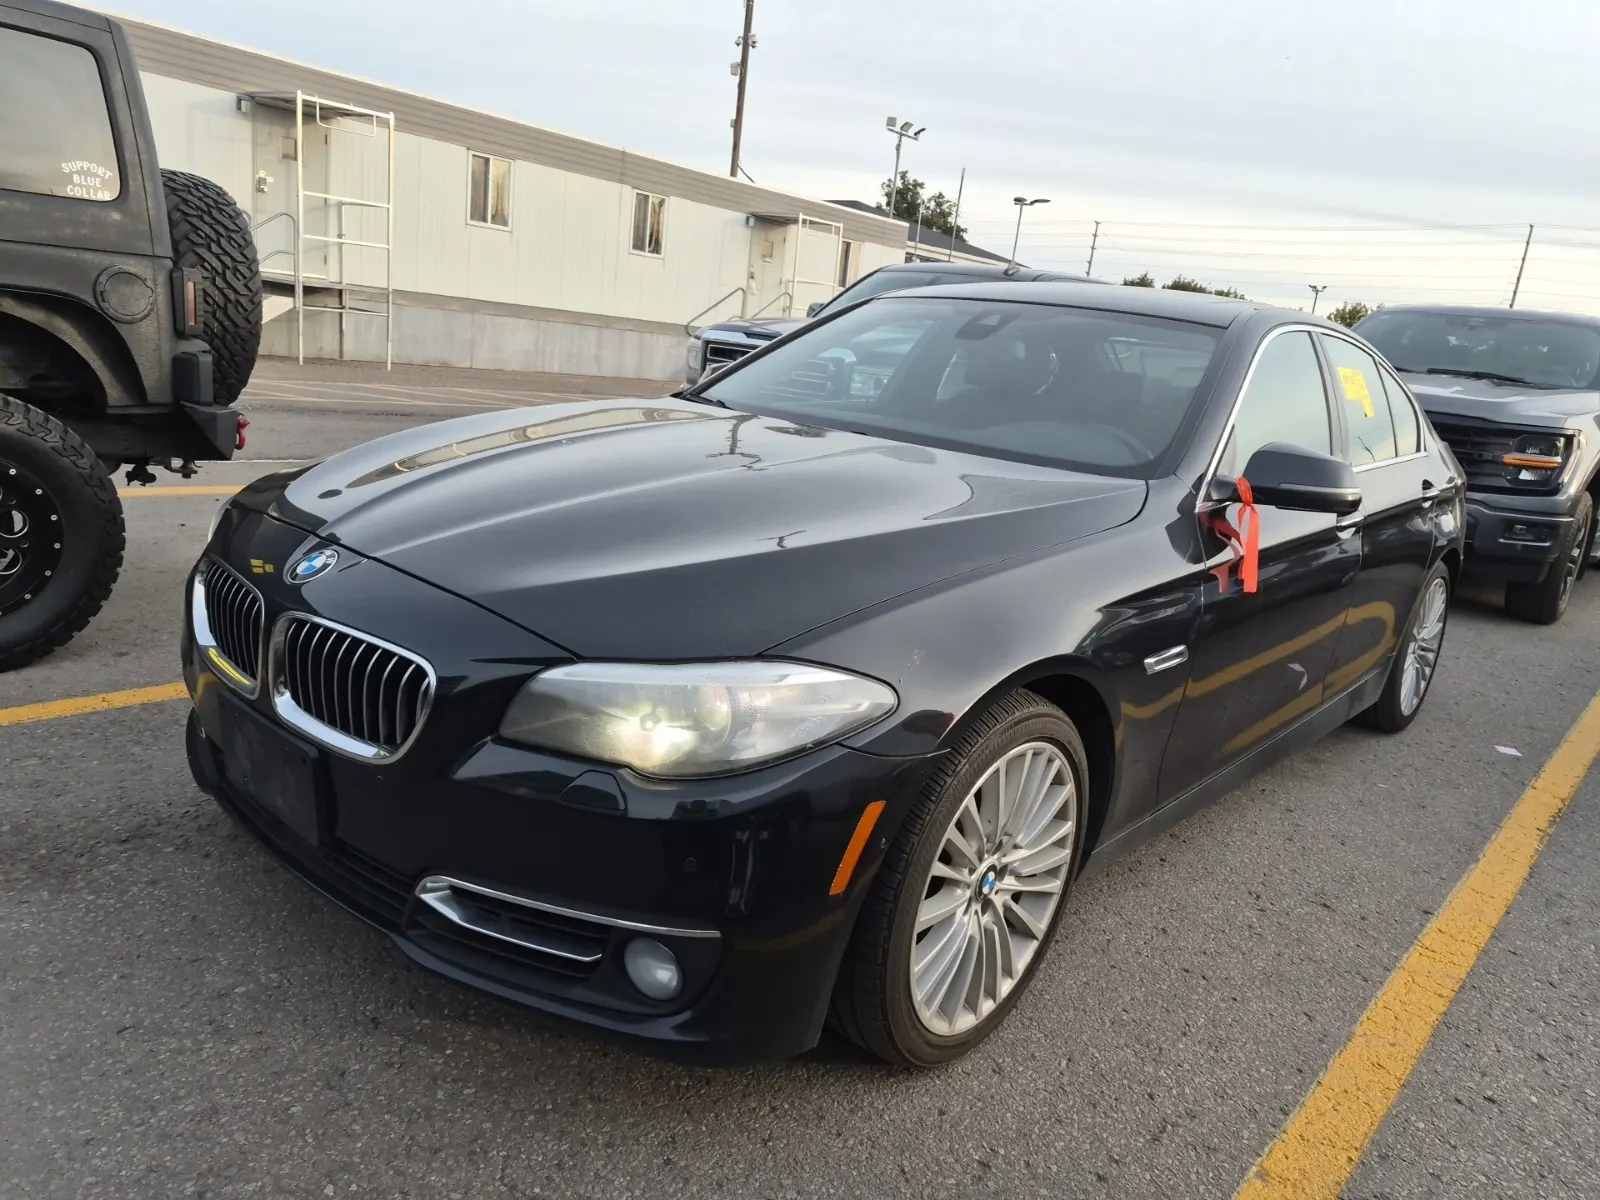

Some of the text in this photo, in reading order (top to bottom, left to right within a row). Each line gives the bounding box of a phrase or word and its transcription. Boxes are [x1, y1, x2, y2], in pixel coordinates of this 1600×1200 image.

[61, 161, 113, 179] SUPPORT
[73, 173, 102, 188] BLUE
[66, 185, 112, 200] COLLAR
